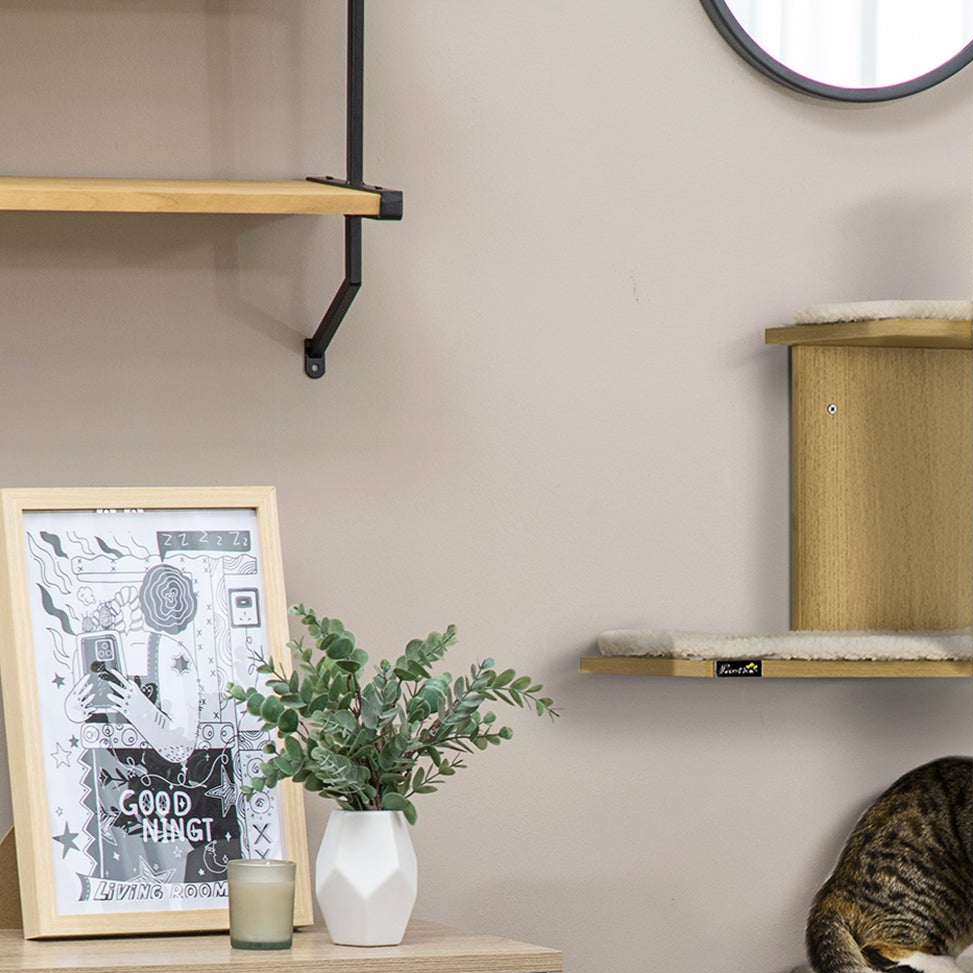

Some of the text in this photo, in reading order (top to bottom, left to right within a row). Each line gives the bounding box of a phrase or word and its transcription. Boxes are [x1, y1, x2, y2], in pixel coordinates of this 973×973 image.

[119, 789, 192, 817] GOOD
[142, 818, 214, 843] NINGT
[170, 882, 229, 899] ROOM
